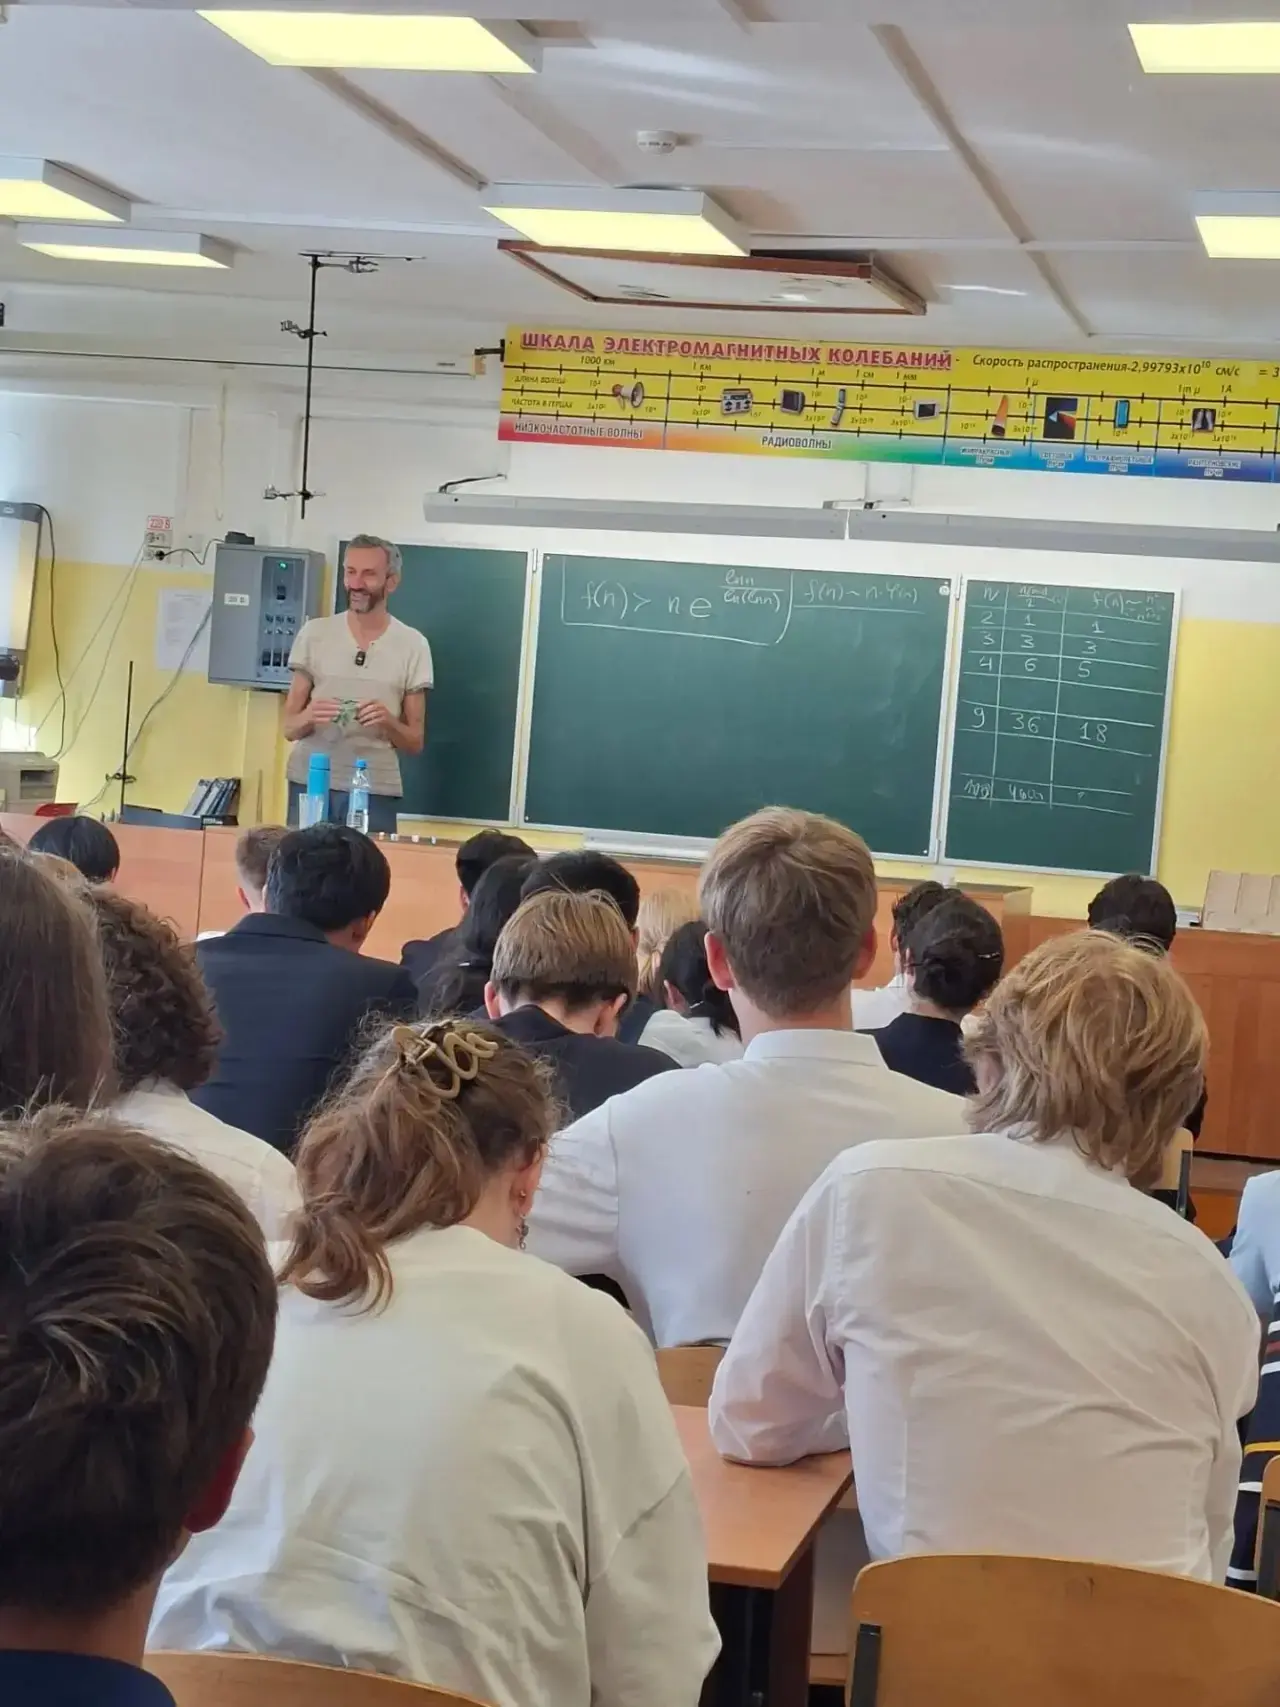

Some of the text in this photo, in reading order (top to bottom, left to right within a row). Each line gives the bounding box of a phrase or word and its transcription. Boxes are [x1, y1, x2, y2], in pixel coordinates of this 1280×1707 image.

[521, 332, 952, 370] ШКАЛА ЭЛЕКТРОМАГНИТНЫХ КОЛЕБАНИЙ
[580, 356, 615, 366] 1000 км
[700, 364, 712, 372] км
[973, 354, 1024, 368] Скорость
[1215, 366, 1240, 377] см/с
[863, 371, 874, 379] см
[511, 398, 541, 407] ЧАСТОТА
[514, 422, 643, 440] НИЗКОЧАСТОТНЫЕ ВОЛНЫ
[762, 436, 832, 449] РАДИОВОЛНЫ
[980, 611, 995, 625] 2
[1025, 614, 1036, 627] 1
[1092, 621, 1105, 634] 1
[981, 631, 996, 646] 3
[1020, 634, 1035, 649] 3
[1082, 640, 1097, 655] 3
[979, 656, 993, 671] 4
[1025, 658, 1038, 672] 6
[1078, 661, 1093, 678] 5
[972, 707, 986, 729] 9
[1010, 712, 1042, 734] 36
[1079, 722, 1108, 744] 18
